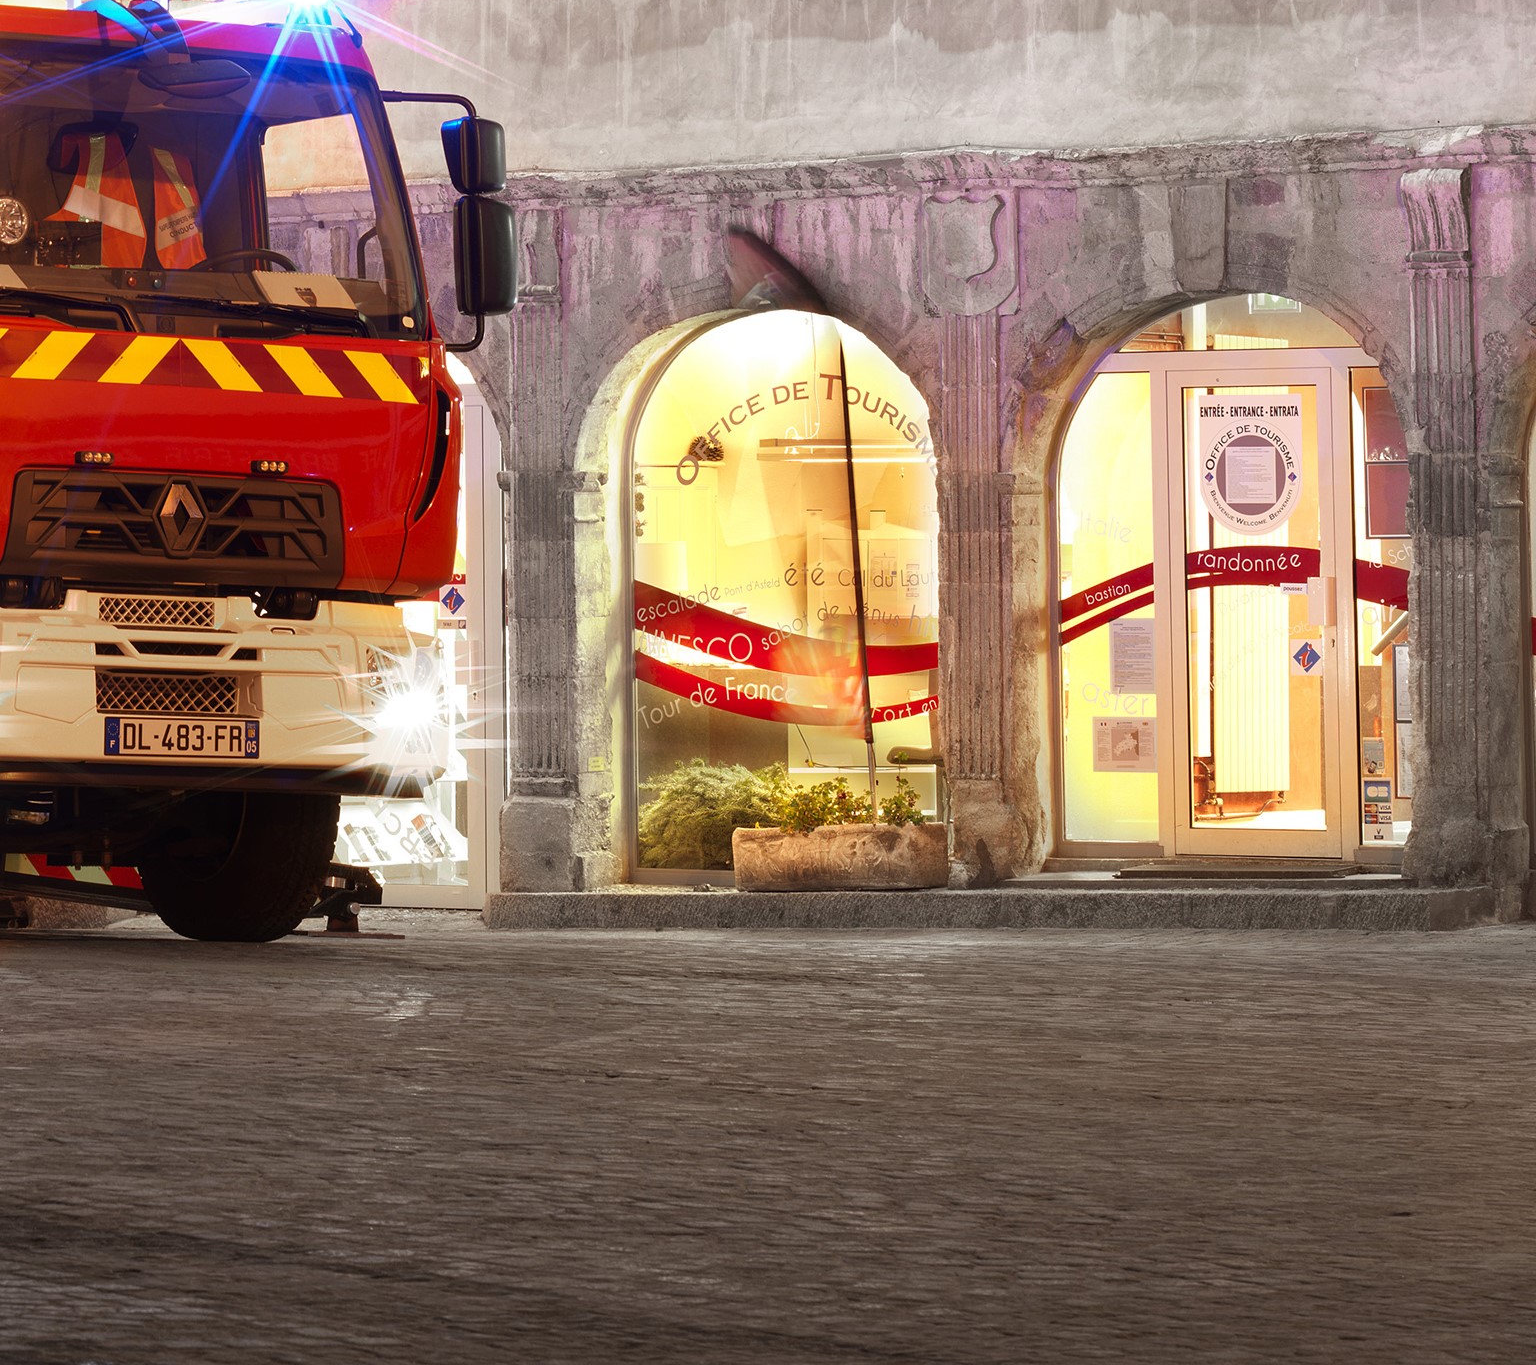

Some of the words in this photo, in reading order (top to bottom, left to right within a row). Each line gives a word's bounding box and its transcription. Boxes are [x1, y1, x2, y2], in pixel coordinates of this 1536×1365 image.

[1200, 404, 1225, 418] ENTRÉE
[1230, 406, 1265, 418] ENTRANCE
[1269, 405, 1299, 417] ENTRATA
[676, 393, 765, 486] OFFICE
[772, 380, 810, 406] DE
[1205, 430, 1235, 471] OFFICE
[1236, 424, 1251, 435] DE
[1253, 424, 1295, 470] TOURISME
[1210, 489, 1235, 521] BIENVENUE
[1236, 516, 1267, 527] WELCOME
[1268, 489, 1293, 521] BENVENUTI
[1080, 509, 1132, 543] Italie
[1197, 552, 1302, 572] randonnée
[1387, 543, 1413, 565] Sch
[724, 585, 744, 598] Pont
[746, 577, 781, 592] d'Asfeld
[784, 562, 825, 587] été
[873, 569, 894, 588] du
[901, 568, 937, 588] Laut
[1282, 585, 1303, 593] poussez
[636, 584, 721, 623] escalade
[1084, 583, 1132, 606] bastion
[761, 609, 809, 651] sabot
[817, 600, 840, 622] de
[637, 697, 681, 730] Tour
[689, 682, 718, 709] de
[724, 676, 799, 702] France
[1082, 682, 1149, 716] aster
[109, 740, 116, 749] F
[122, 722, 242, 752] DL-483-FR
[246, 740, 257, 754] 05
